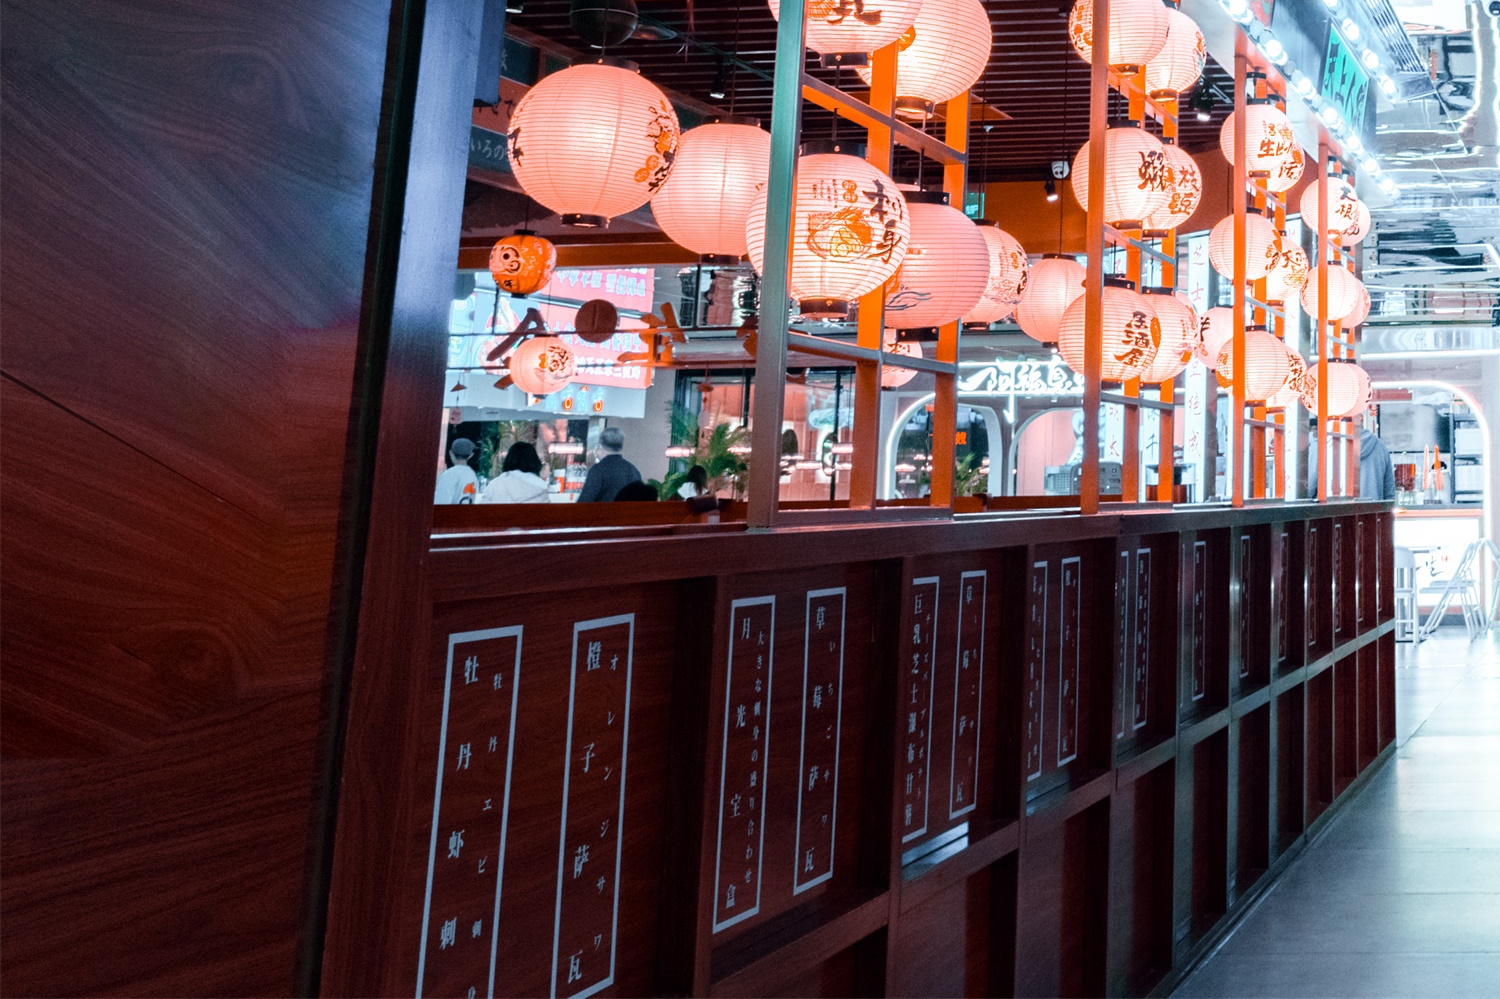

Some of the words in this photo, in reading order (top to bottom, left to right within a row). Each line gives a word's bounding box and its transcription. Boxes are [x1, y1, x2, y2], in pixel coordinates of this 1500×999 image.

[567, 641, 602, 984] 橙子萨瓦
[592, 654, 618, 950] オレンジサワ
[725, 617, 751, 908] 月光宝盒
[804, 606, 827, 872] 草莓萨瓦
